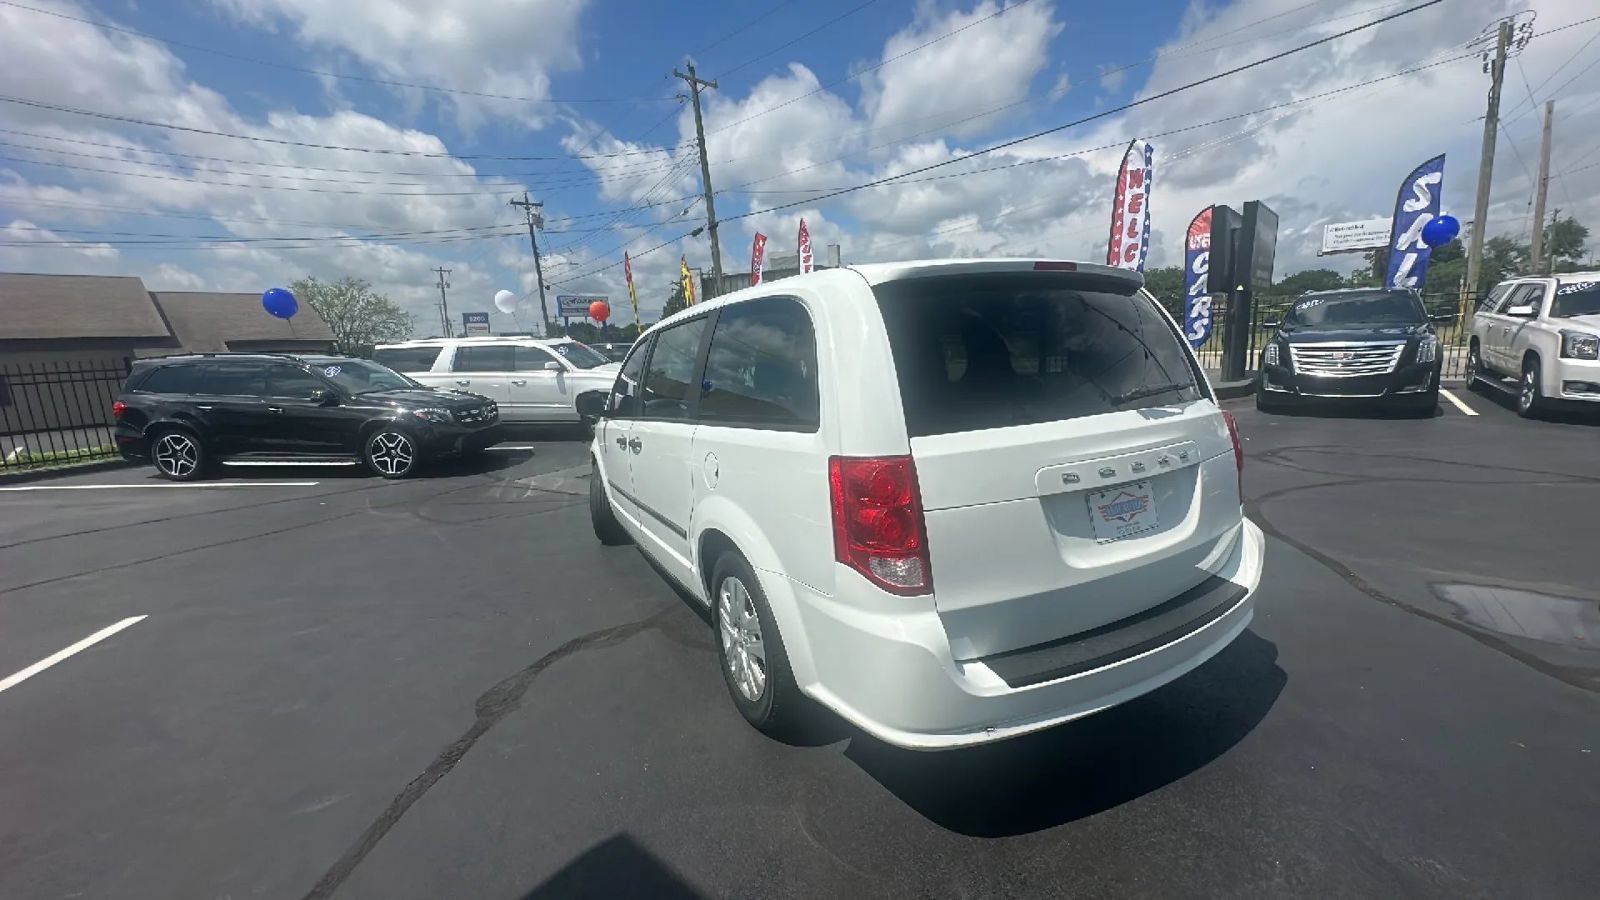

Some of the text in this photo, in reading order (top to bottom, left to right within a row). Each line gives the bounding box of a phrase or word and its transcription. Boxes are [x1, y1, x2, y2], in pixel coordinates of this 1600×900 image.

[1124, 168, 1146, 270] WELC
[1188, 233, 1211, 250] USE
[1393, 171, 1442, 289] SAL
[1188, 251, 1213, 341] CARS
[1061, 450, 1190, 485] DODGE
